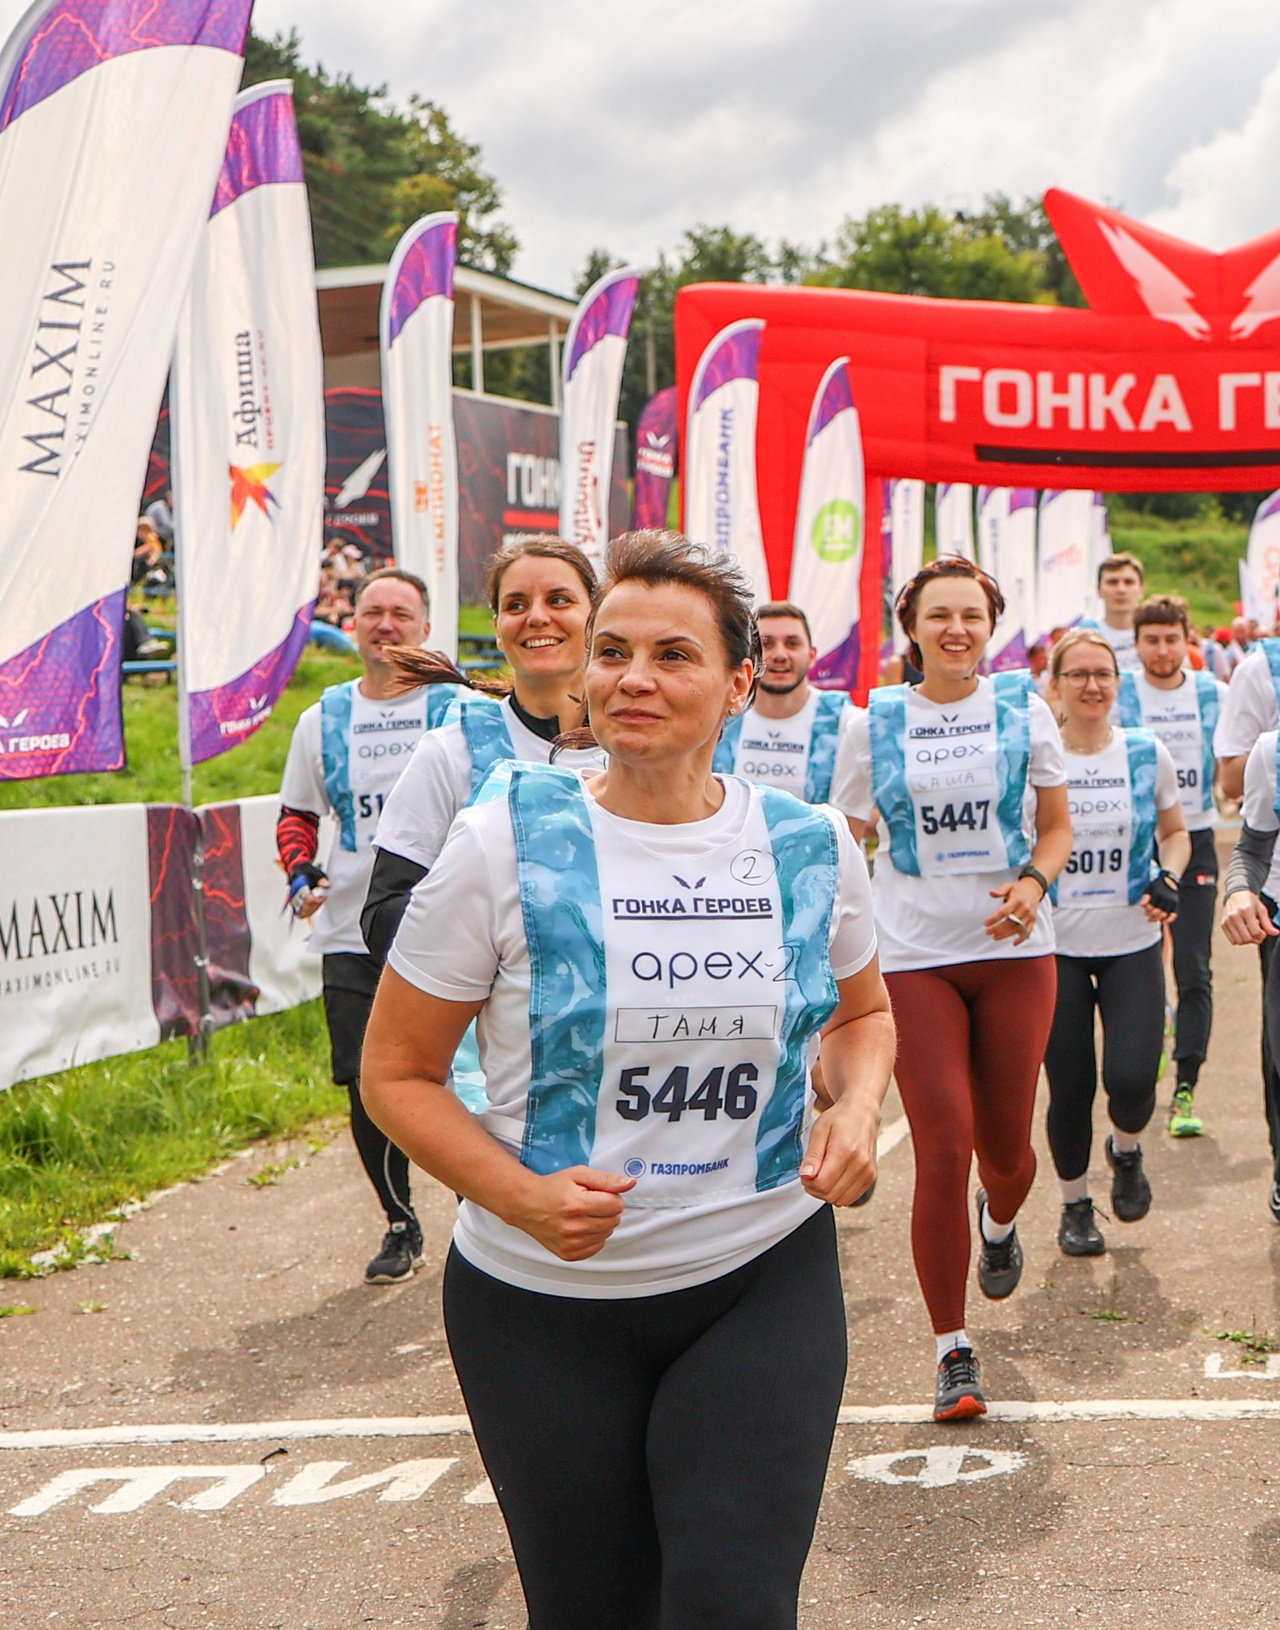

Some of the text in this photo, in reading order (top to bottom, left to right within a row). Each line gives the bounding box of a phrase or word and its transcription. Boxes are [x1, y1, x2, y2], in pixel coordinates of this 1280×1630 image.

[17, 257, 92, 478] MAXIM
[74, 260, 116, 457] XIMONLINE.RU
[233, 329, 262, 449] Афиша
[938, 365, 1193, 432] ГОНКА
[716, 407, 734, 550] ЗПРОМБАНК
[9, 733, 71, 753] ГЕРОЕВ
[909, 723, 991, 737] ГОНКА ГЕРОЕВ
[359, 741, 416, 759] apex
[916, 744, 983, 765] apex
[743, 761, 796, 777] apex
[1176, 769, 1198, 788] 50
[359, 794, 384, 818] 51
[921, 800, 990, 835] 5447
[1065, 849, 1122, 874] 5019
[612, 897, 773, 914] ГОНКА ГЕРОЕВ
[0, 887, 118, 961] MAXIM
[0, 959, 121, 994] AXIMONLINE.RU
[632, 951, 764, 989] apex
[616, 1063, 758, 1122] 5446
[651, 1158, 729, 1175] ГАЗПРОМБАНК
